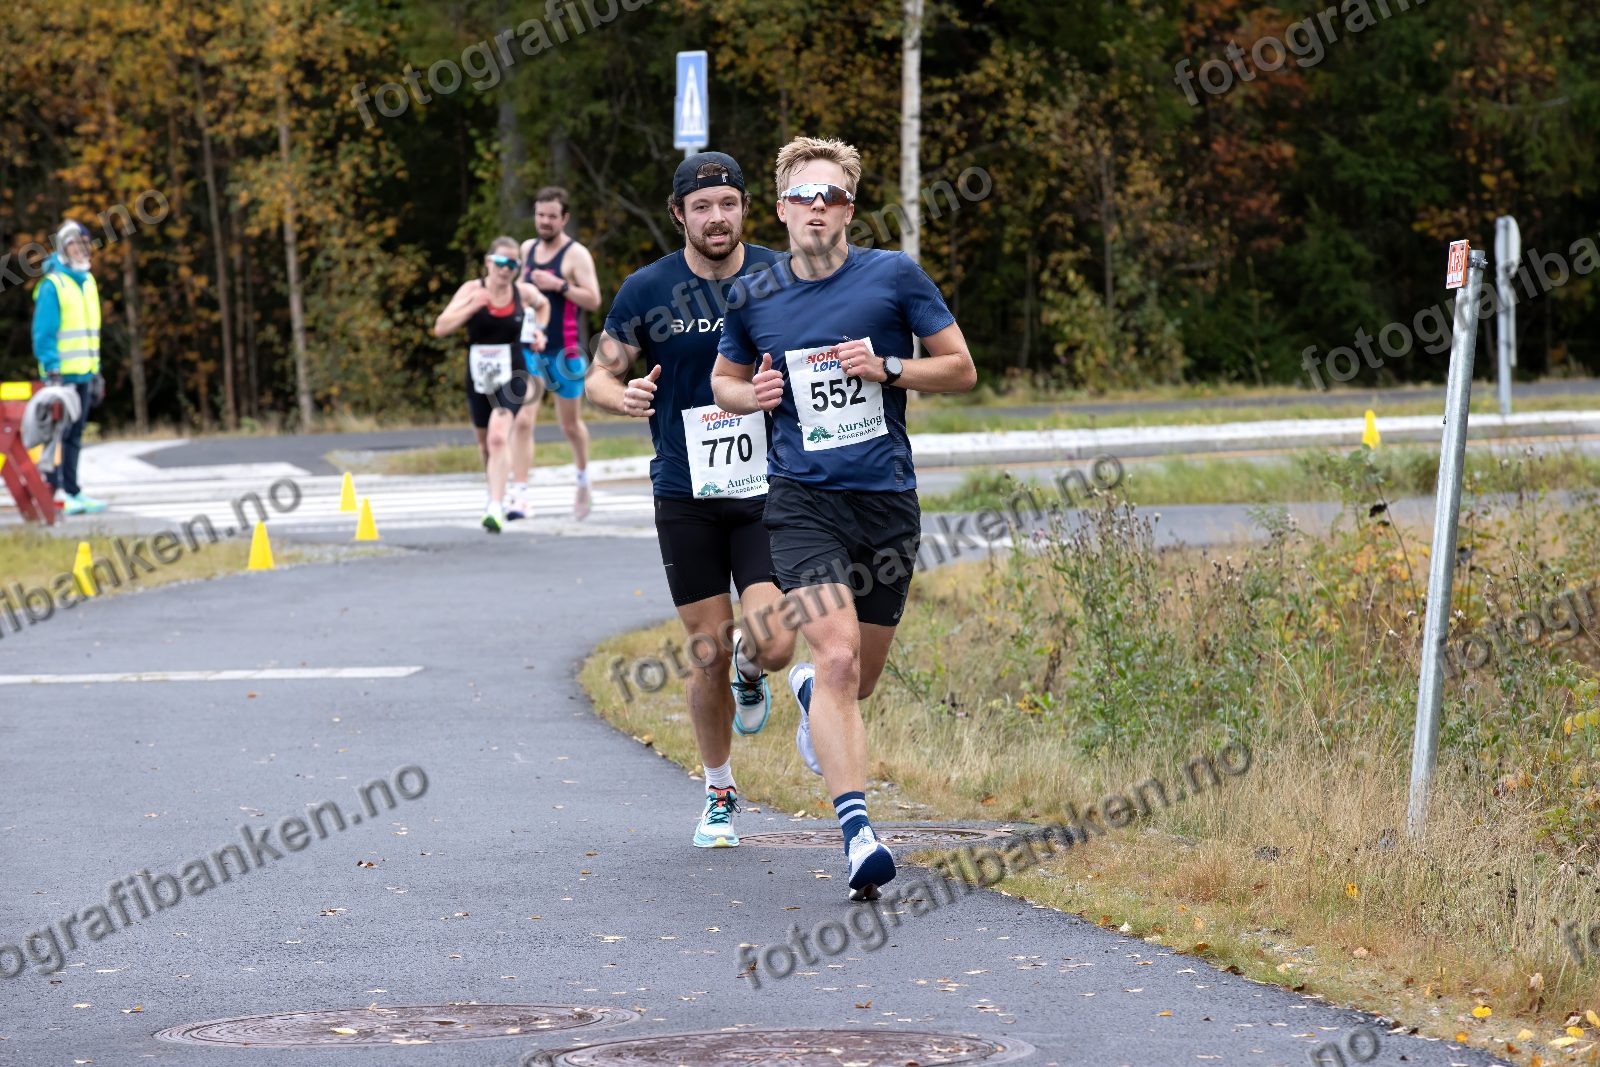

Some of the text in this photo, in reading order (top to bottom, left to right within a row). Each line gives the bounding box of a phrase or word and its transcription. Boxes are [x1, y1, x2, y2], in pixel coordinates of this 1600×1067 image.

[813, 360, 842, 373] LØPE
[810, 375, 867, 412] 552
[706, 417, 743, 431] LØPET
[837, 415, 882, 434] Aurskog
[702, 433, 753, 468] 770
[727, 474, 767, 489] Aurskog
